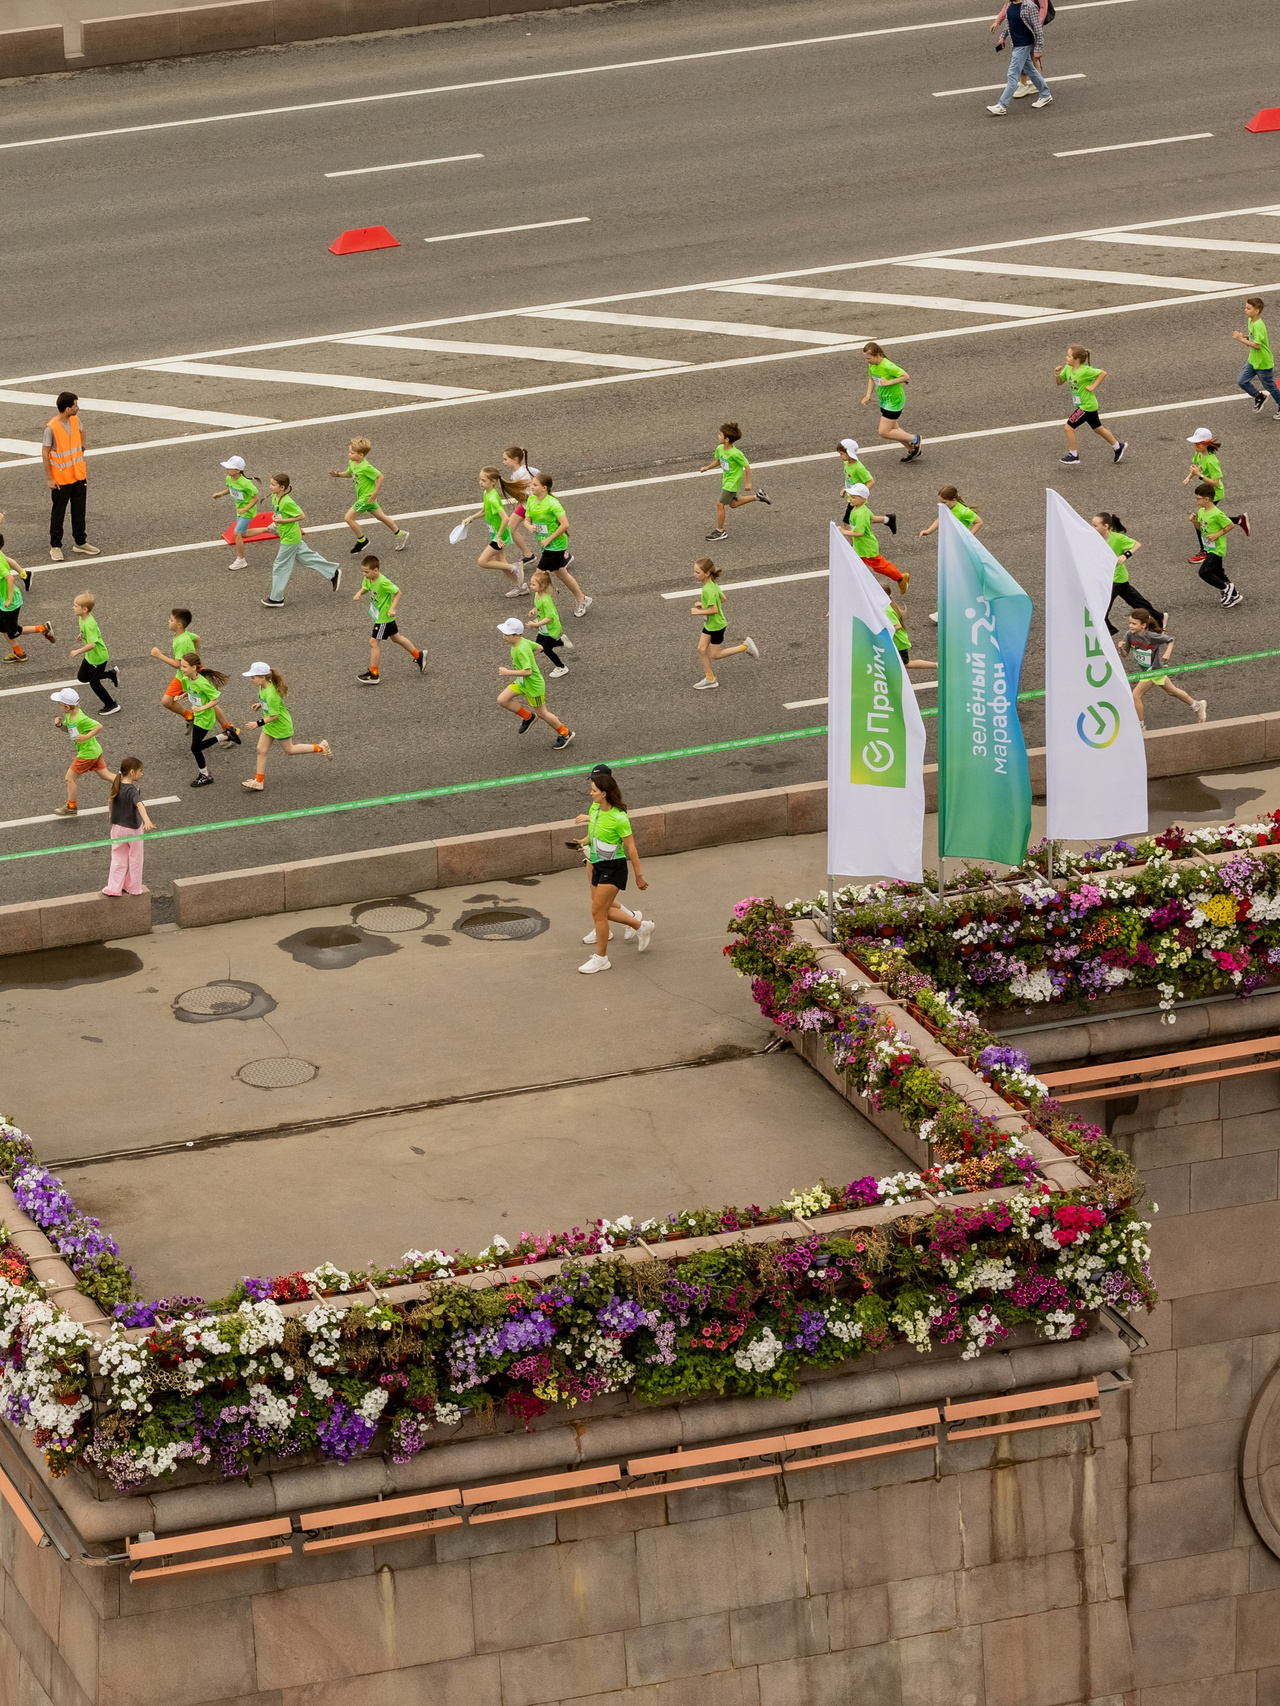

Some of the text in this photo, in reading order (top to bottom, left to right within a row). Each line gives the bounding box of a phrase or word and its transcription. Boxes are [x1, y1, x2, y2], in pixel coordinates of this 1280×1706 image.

[866, 644, 895, 733] Прайм
[966, 652, 987, 757] зелёный
[987, 662, 1012, 775] марафон
